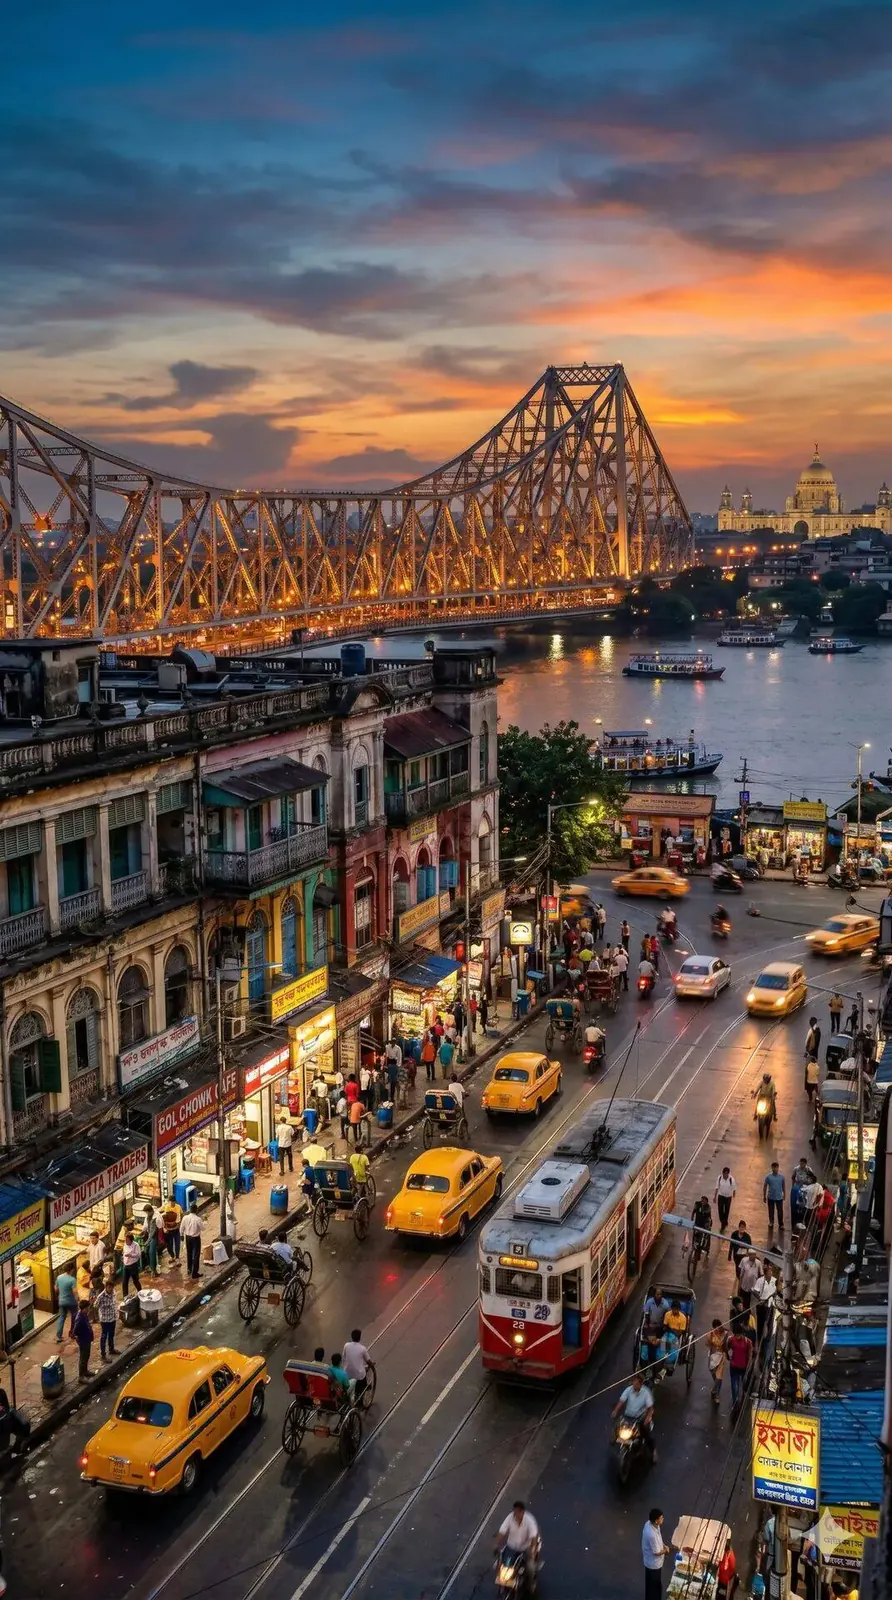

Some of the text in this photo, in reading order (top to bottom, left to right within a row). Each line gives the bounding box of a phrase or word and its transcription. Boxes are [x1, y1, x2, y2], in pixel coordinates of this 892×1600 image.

[158, 1112, 178, 1135] GOL
[179, 1086, 213, 1122] CHOWK
[53, 1194, 71, 1219] M/S
[74, 1174, 105, 1207] DUTTA
[106, 1146, 147, 1184] TRADERS
